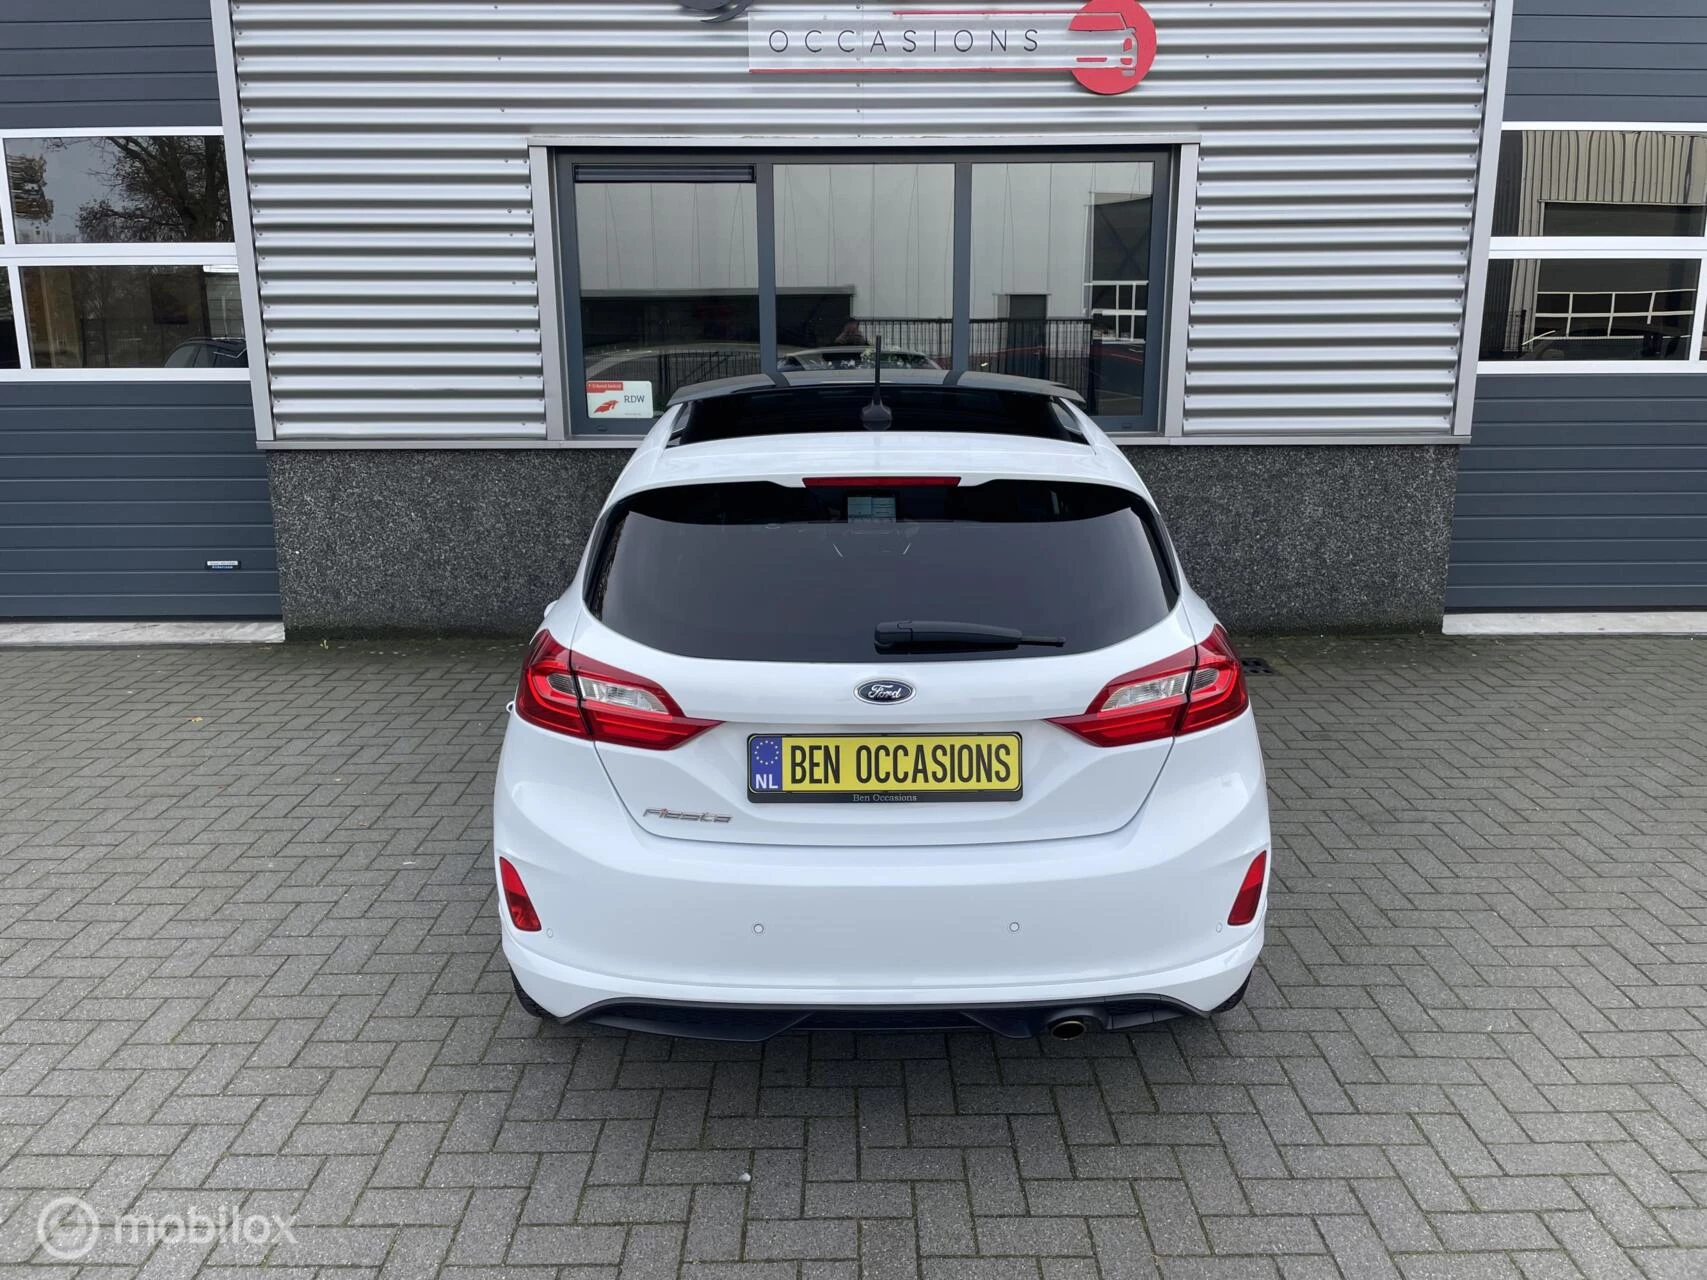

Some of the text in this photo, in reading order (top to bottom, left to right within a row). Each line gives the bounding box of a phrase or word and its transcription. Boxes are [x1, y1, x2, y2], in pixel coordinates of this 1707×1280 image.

[768, 29, 1040, 53] OCCASIONS
[624, 395, 645, 403] RDW
[868, 683, 902, 699] Ford
[790, 743, 1011, 784] BEN OCCASIONS
[755, 773, 778, 789] NL
[853, 793, 917, 803] Ben Occasions
